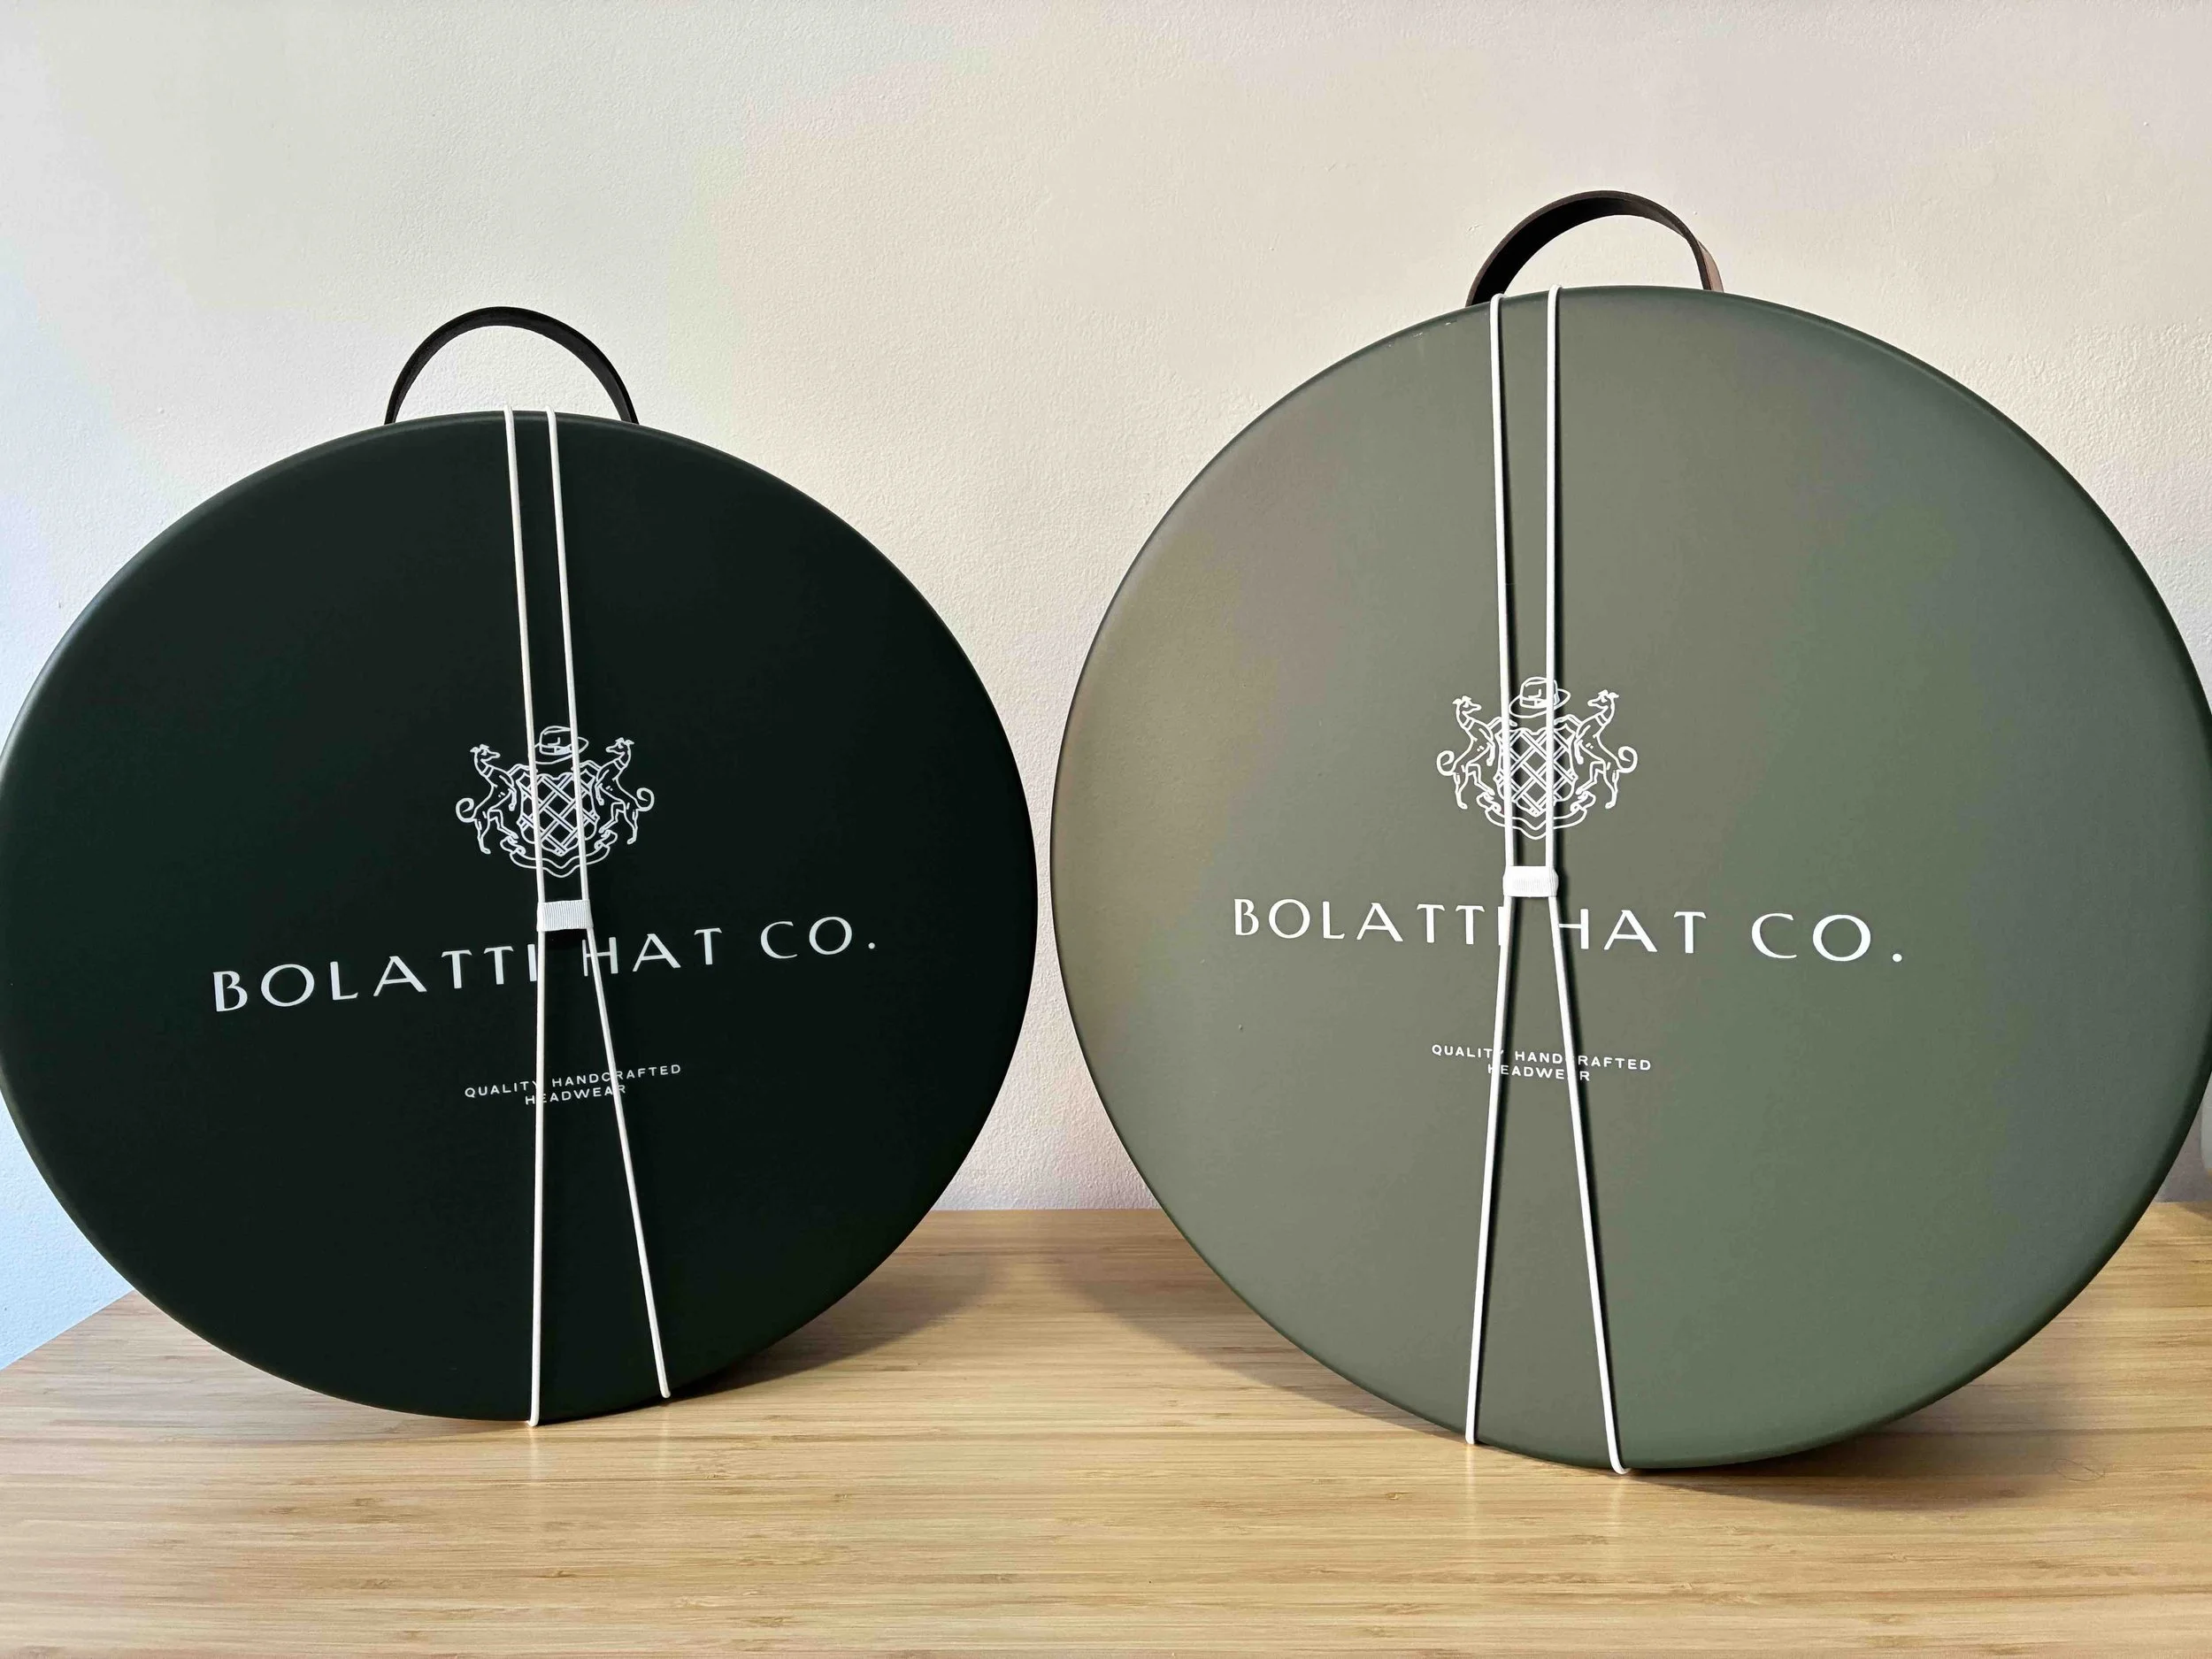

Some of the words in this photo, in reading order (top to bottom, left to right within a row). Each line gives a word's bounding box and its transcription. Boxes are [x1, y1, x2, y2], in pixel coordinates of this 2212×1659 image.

[1232, 897, 1507, 947] BOLATTI
[1551, 907, 1708, 955] HAT
[1751, 912, 1903, 963] CO.
[212, 943, 537, 1012] BOLATTI
[581, 927, 723, 977] HAT
[760, 916, 877, 959] CO.
[1514, 1050, 1652, 1071] HANDRAFTED
[551, 1064, 681, 1088] HANDCRAFTED
[1487, 1064, 1591, 1082] HEADWER
